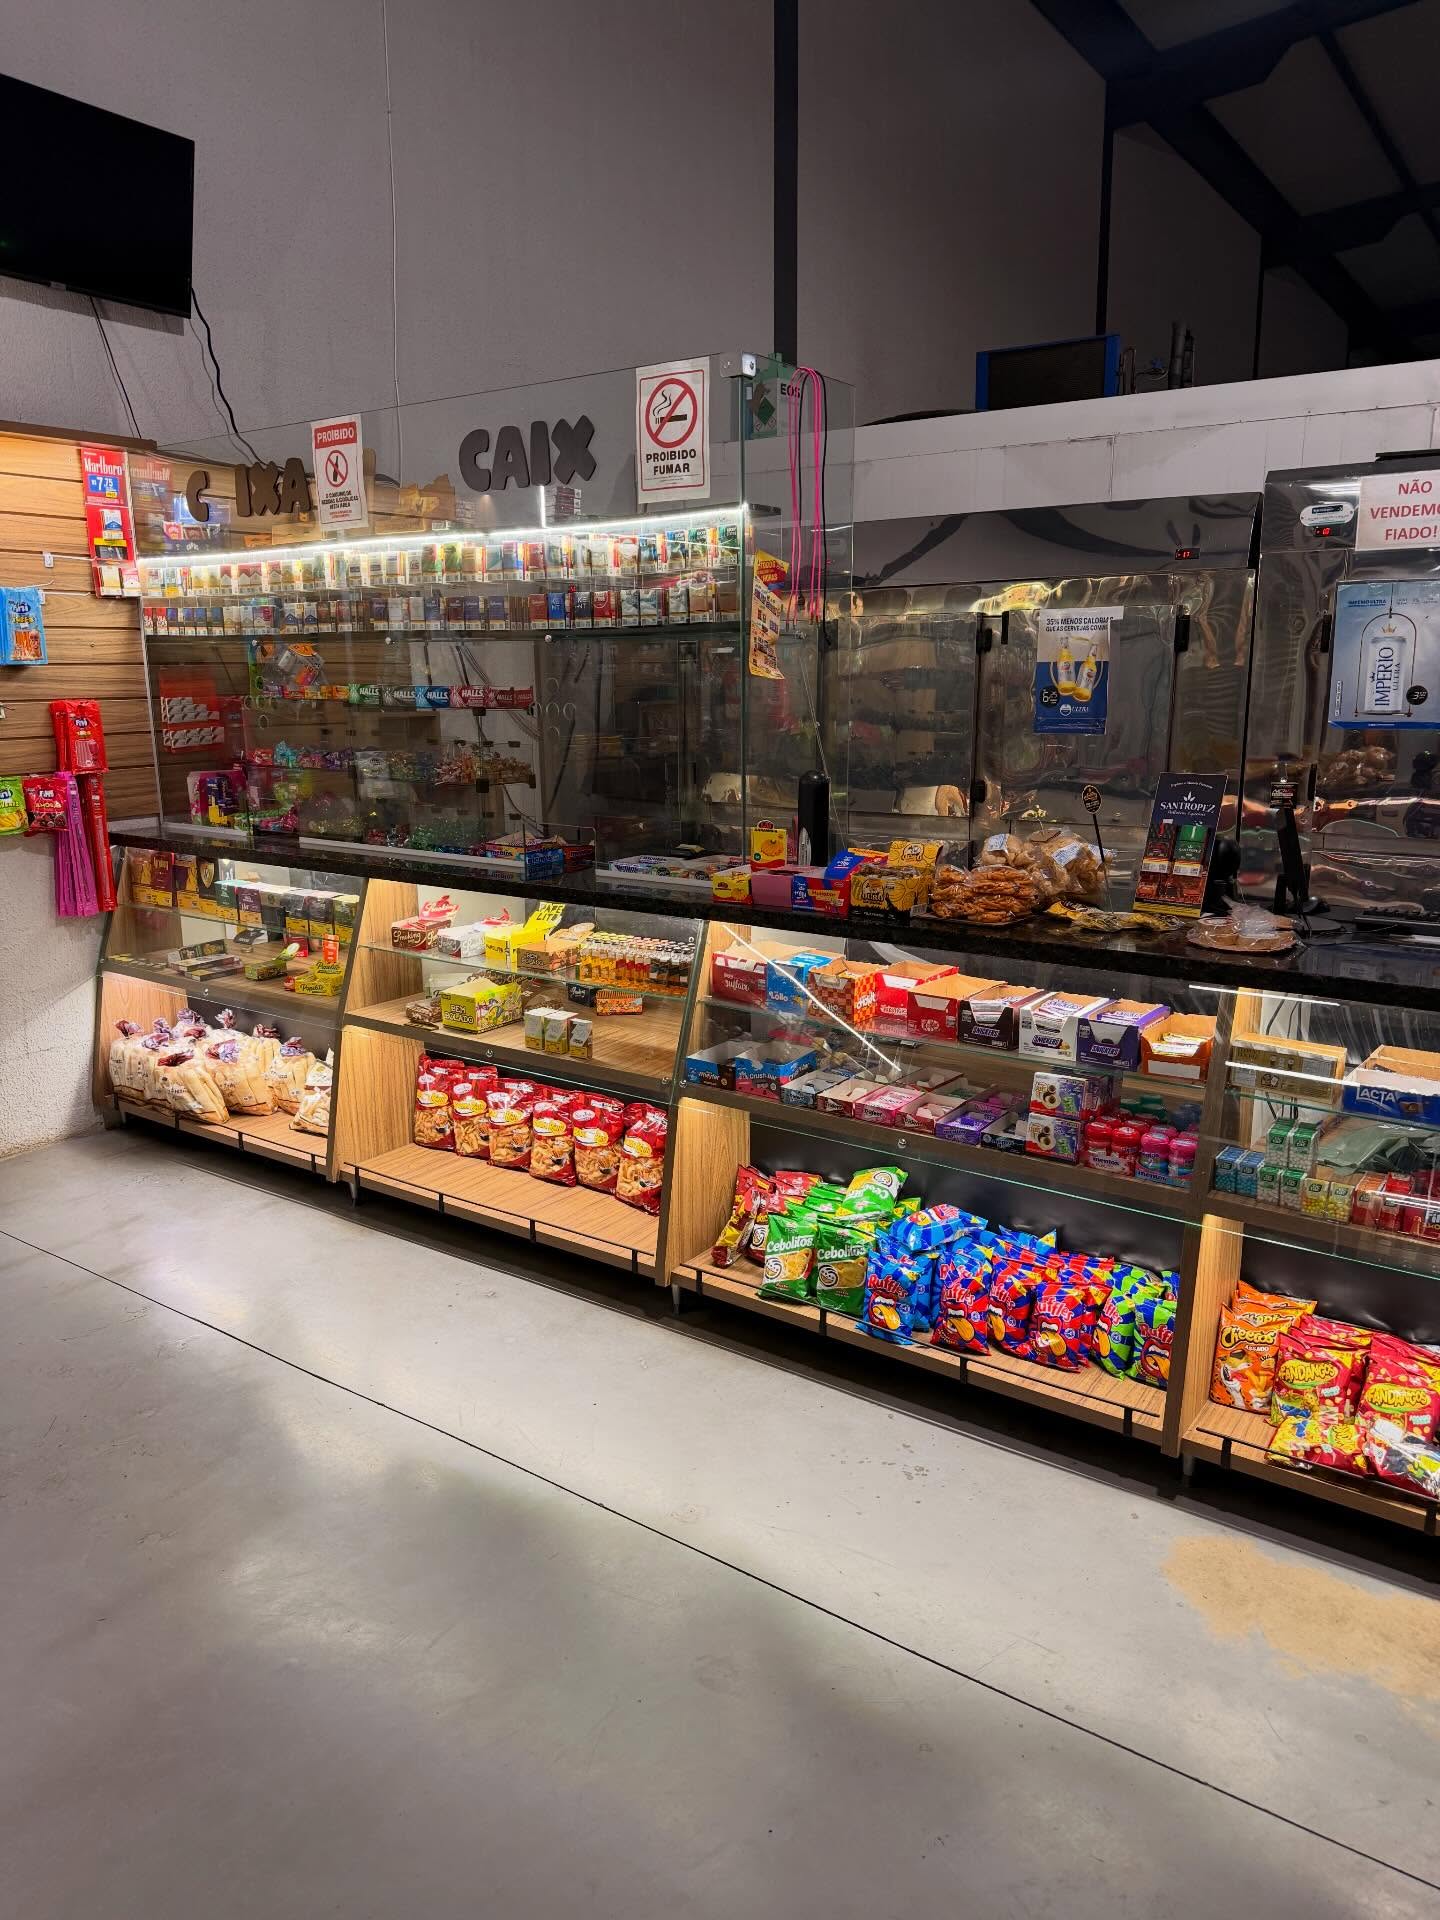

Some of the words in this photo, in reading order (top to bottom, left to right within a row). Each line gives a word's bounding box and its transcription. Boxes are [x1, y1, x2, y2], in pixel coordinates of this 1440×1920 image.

[317, 427, 354, 443] PROIBIDO
[646, 448, 697, 464] PROIBIDO
[84, 456, 122, 475] Marlboro
[653, 463, 690, 475] FUMAR
[1398, 479, 1433, 495] NÃO
[1385, 525, 1437, 541] FIADO!
[1061, 617, 1083, 625] MENOS
[359, 687, 379, 695] HALLS
[393, 690, 415, 698] HALLS
[427, 691, 448, 699] HALLS
[461, 688, 484, 697] HALLS
[1160, 801, 1215, 813] SANTROPEZ
[450, 1004, 466, 1014] BEM
[444, 1012, 475, 1024] BOLADO
[971, 1026, 1000, 1038] SNICKERS
[1033, 1034, 1062, 1047] SNICKERS
[1091, 1045, 1120, 1056] SNICKERS
[767, 1234, 814, 1252] Cebolitos
[817, 1243, 867, 1260] Cebolitos
[868, 1274, 909, 1299] Ruffles
[1221, 1326, 1276, 1348] Cheetos
[1279, 1362, 1336, 1384] FANDANGOS
[1368, 1388, 1430, 1406] FANDANGOS
